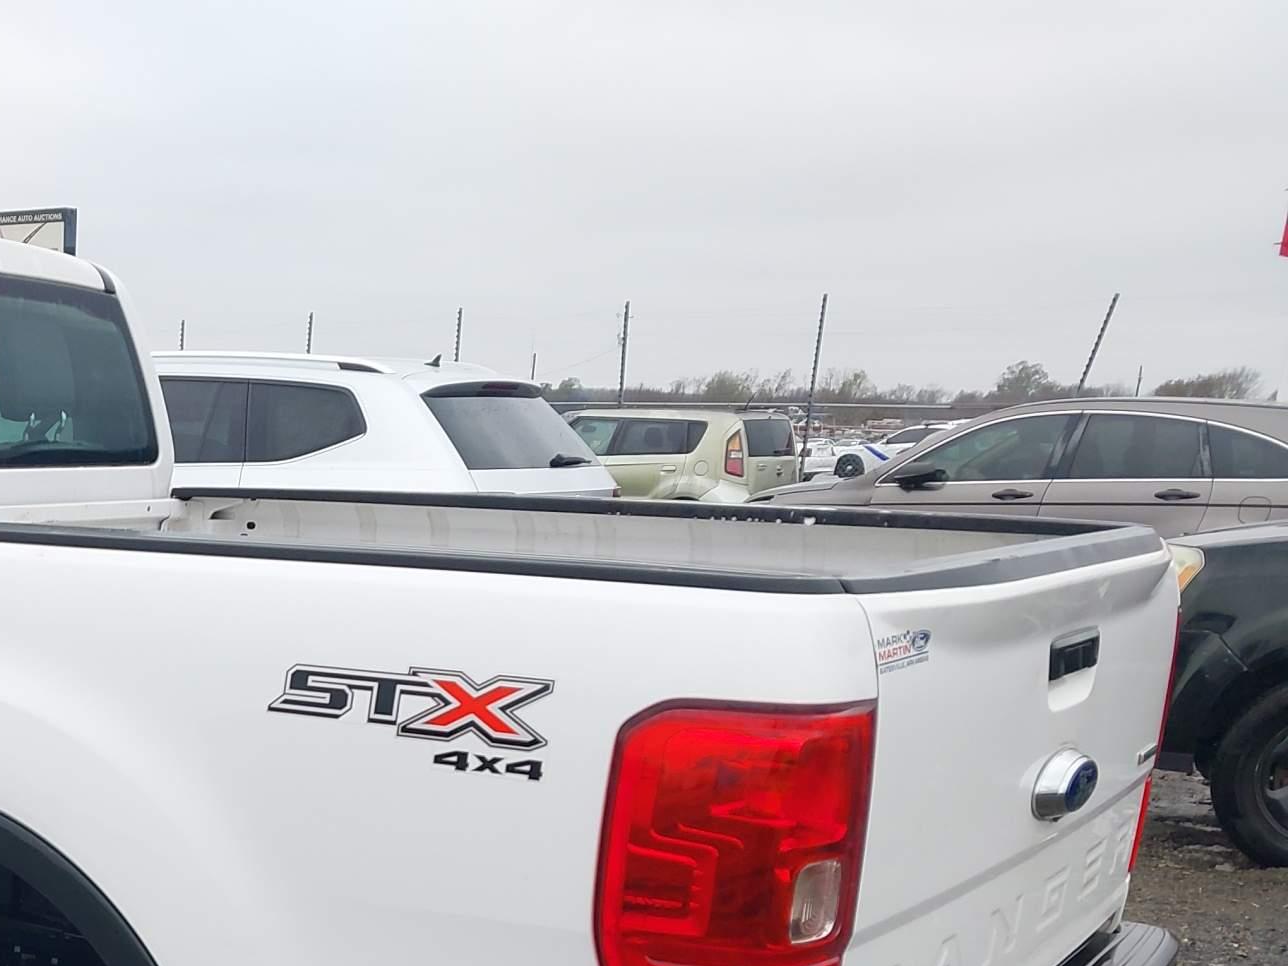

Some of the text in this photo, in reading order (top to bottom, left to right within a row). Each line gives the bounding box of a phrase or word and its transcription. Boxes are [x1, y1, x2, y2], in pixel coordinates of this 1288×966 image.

[18, 214, 33, 222] AUTO
[34, 213, 62, 221] AUCTIONS
[267, 663, 556, 751] STX
